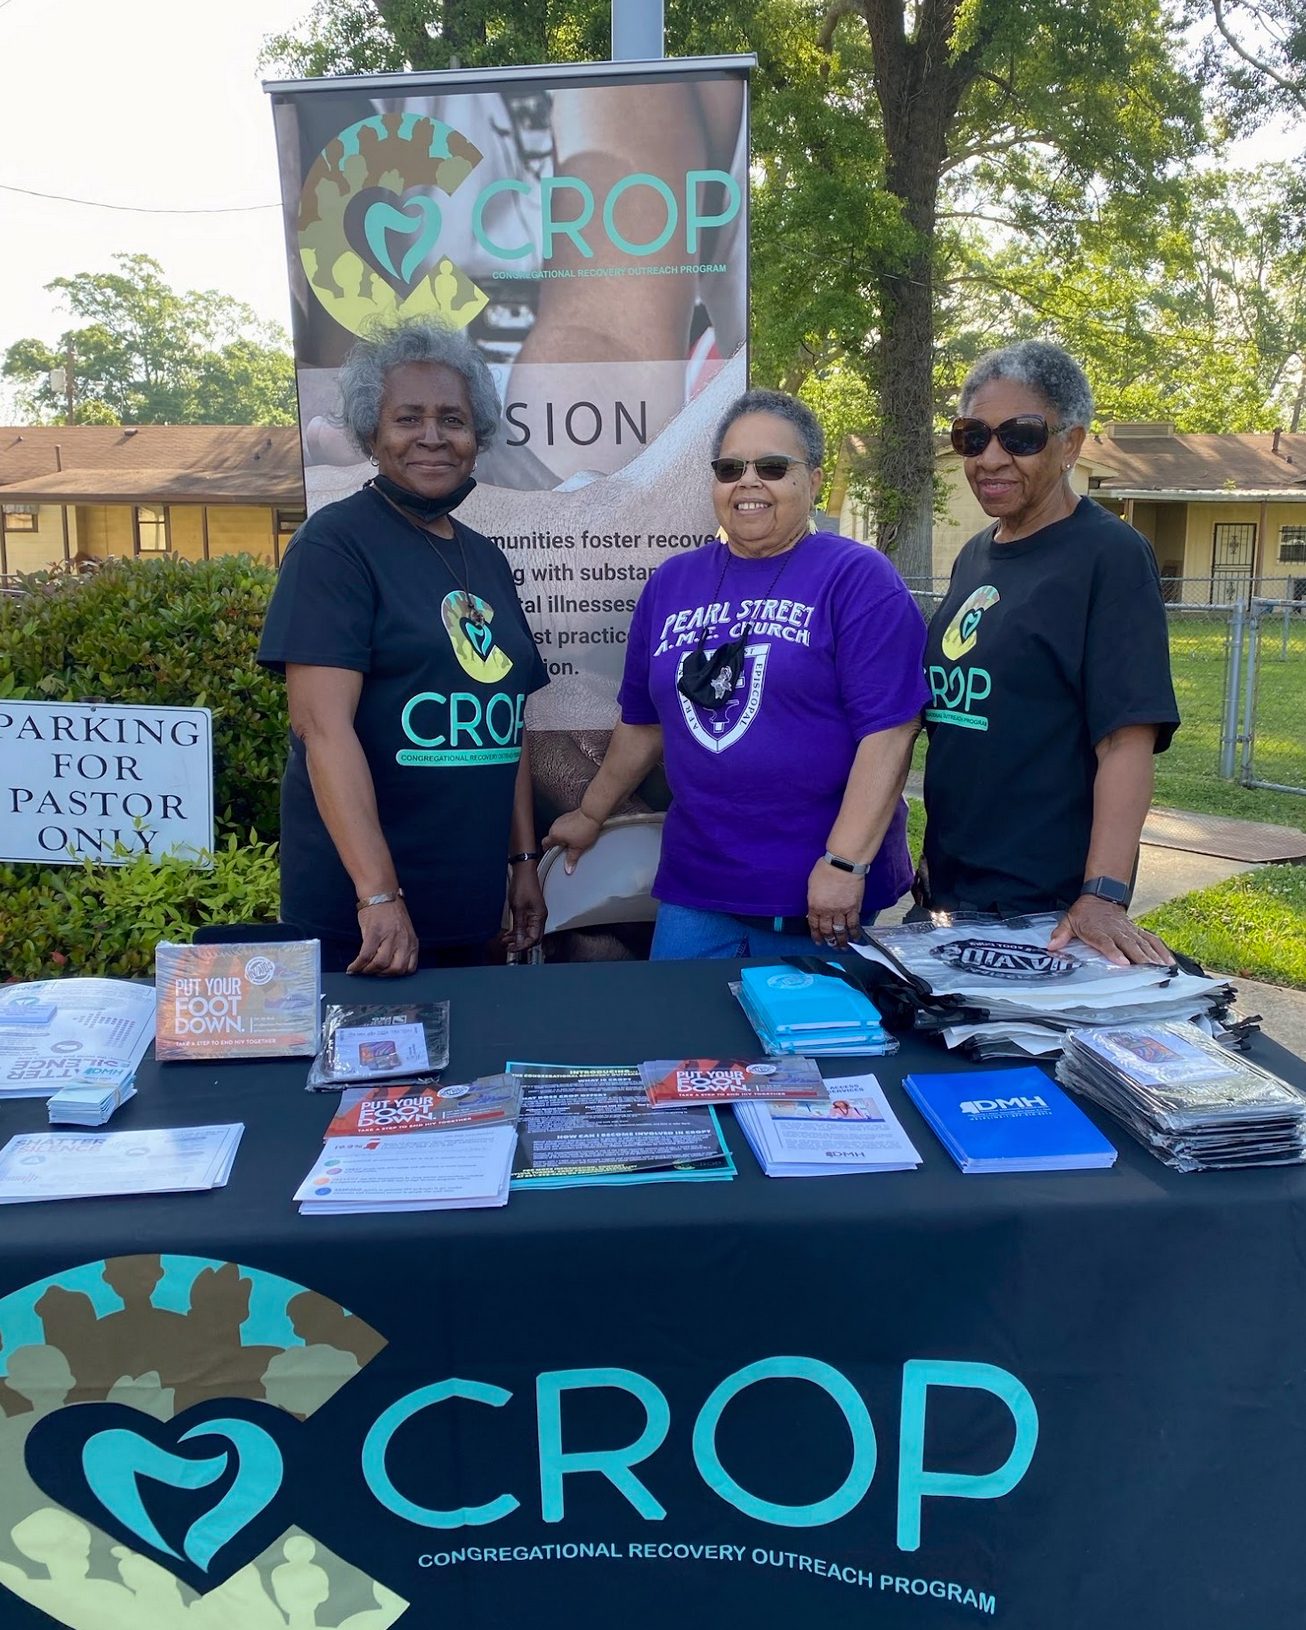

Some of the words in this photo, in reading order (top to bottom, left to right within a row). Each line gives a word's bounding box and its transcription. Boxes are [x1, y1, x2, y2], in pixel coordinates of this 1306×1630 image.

[471, 169, 741, 260] CROP
[492, 269, 576, 280] CONGREGATIONAL
[577, 268, 626, 278] RECOVERY
[629, 266, 678, 276] OUTREACH
[680, 264, 727, 274] PROGRAM
[505, 401, 647, 447] SION
[581, 530, 641, 548] foster
[532, 563, 574, 581] with
[548, 594, 636, 613] illnesses
[660, 602, 731, 640] PEARL
[736, 599, 815, 627] STREET
[558, 627, 629, 648] practic
[741, 663, 763, 725] EPISCOPAL
[929, 665, 992, 712] ROP
[0, 713, 200, 747] PARKING
[51, 753, 143, 781] FOR
[400, 754, 468, 762] CONGREGATIONAL
[8, 788, 188, 820] PASTOR
[38, 826, 160, 855] ONLY
[175, 979, 202, 997] PUT
[205, 977, 242, 996] YOUR
[175, 996, 242, 1018] FOOT
[175, 1016, 245, 1035] DOWN.
[676, 1070, 702, 1078] PUT
[706, 1070, 743, 1078] YOUR
[676, 1077, 745, 1086] FOOT
[676, 1084, 751, 1093] DOWN.
[360, 1104, 433, 1119] FOOT
[361, 1100, 391, 1110] PUT
[394, 1096, 433, 1107] YOUR
[973, 1096, 1047, 1111] DMH
[357, 1112, 437, 1127] DOWN.
[15, 1138, 106, 1147] SHATTER
[361, 1355, 1039, 1551] CROP
[417, 1541, 623, 1568] CONGREGATIONAL
[628, 1542, 746, 1563] RECOVERY
[751, 1547, 873, 1590] OUTREACH
[879, 1573, 997, 1615] PROGRAM
